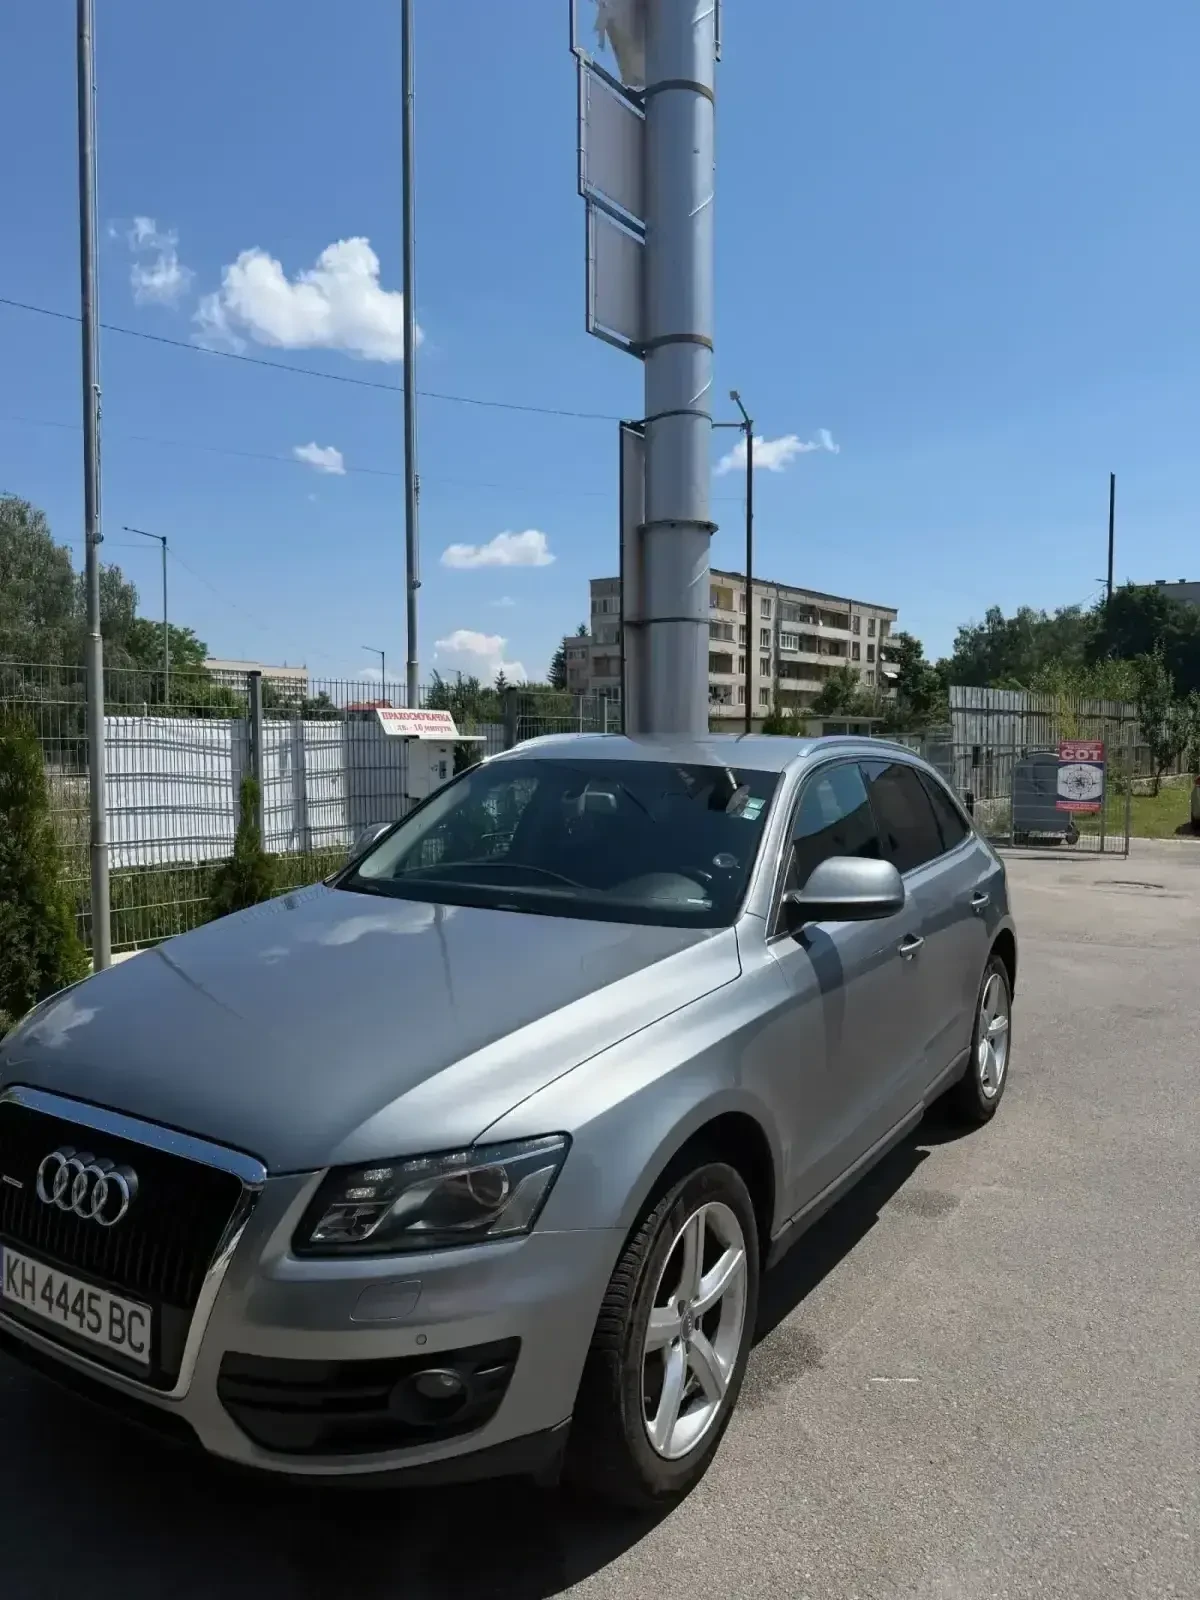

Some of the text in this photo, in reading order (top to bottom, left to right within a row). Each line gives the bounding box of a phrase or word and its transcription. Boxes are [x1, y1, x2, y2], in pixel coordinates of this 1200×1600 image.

[381, 711, 451, 722] ПРАХОСМУКАЧКА
[6, 1254, 146, 1354] KH 4445 BC
